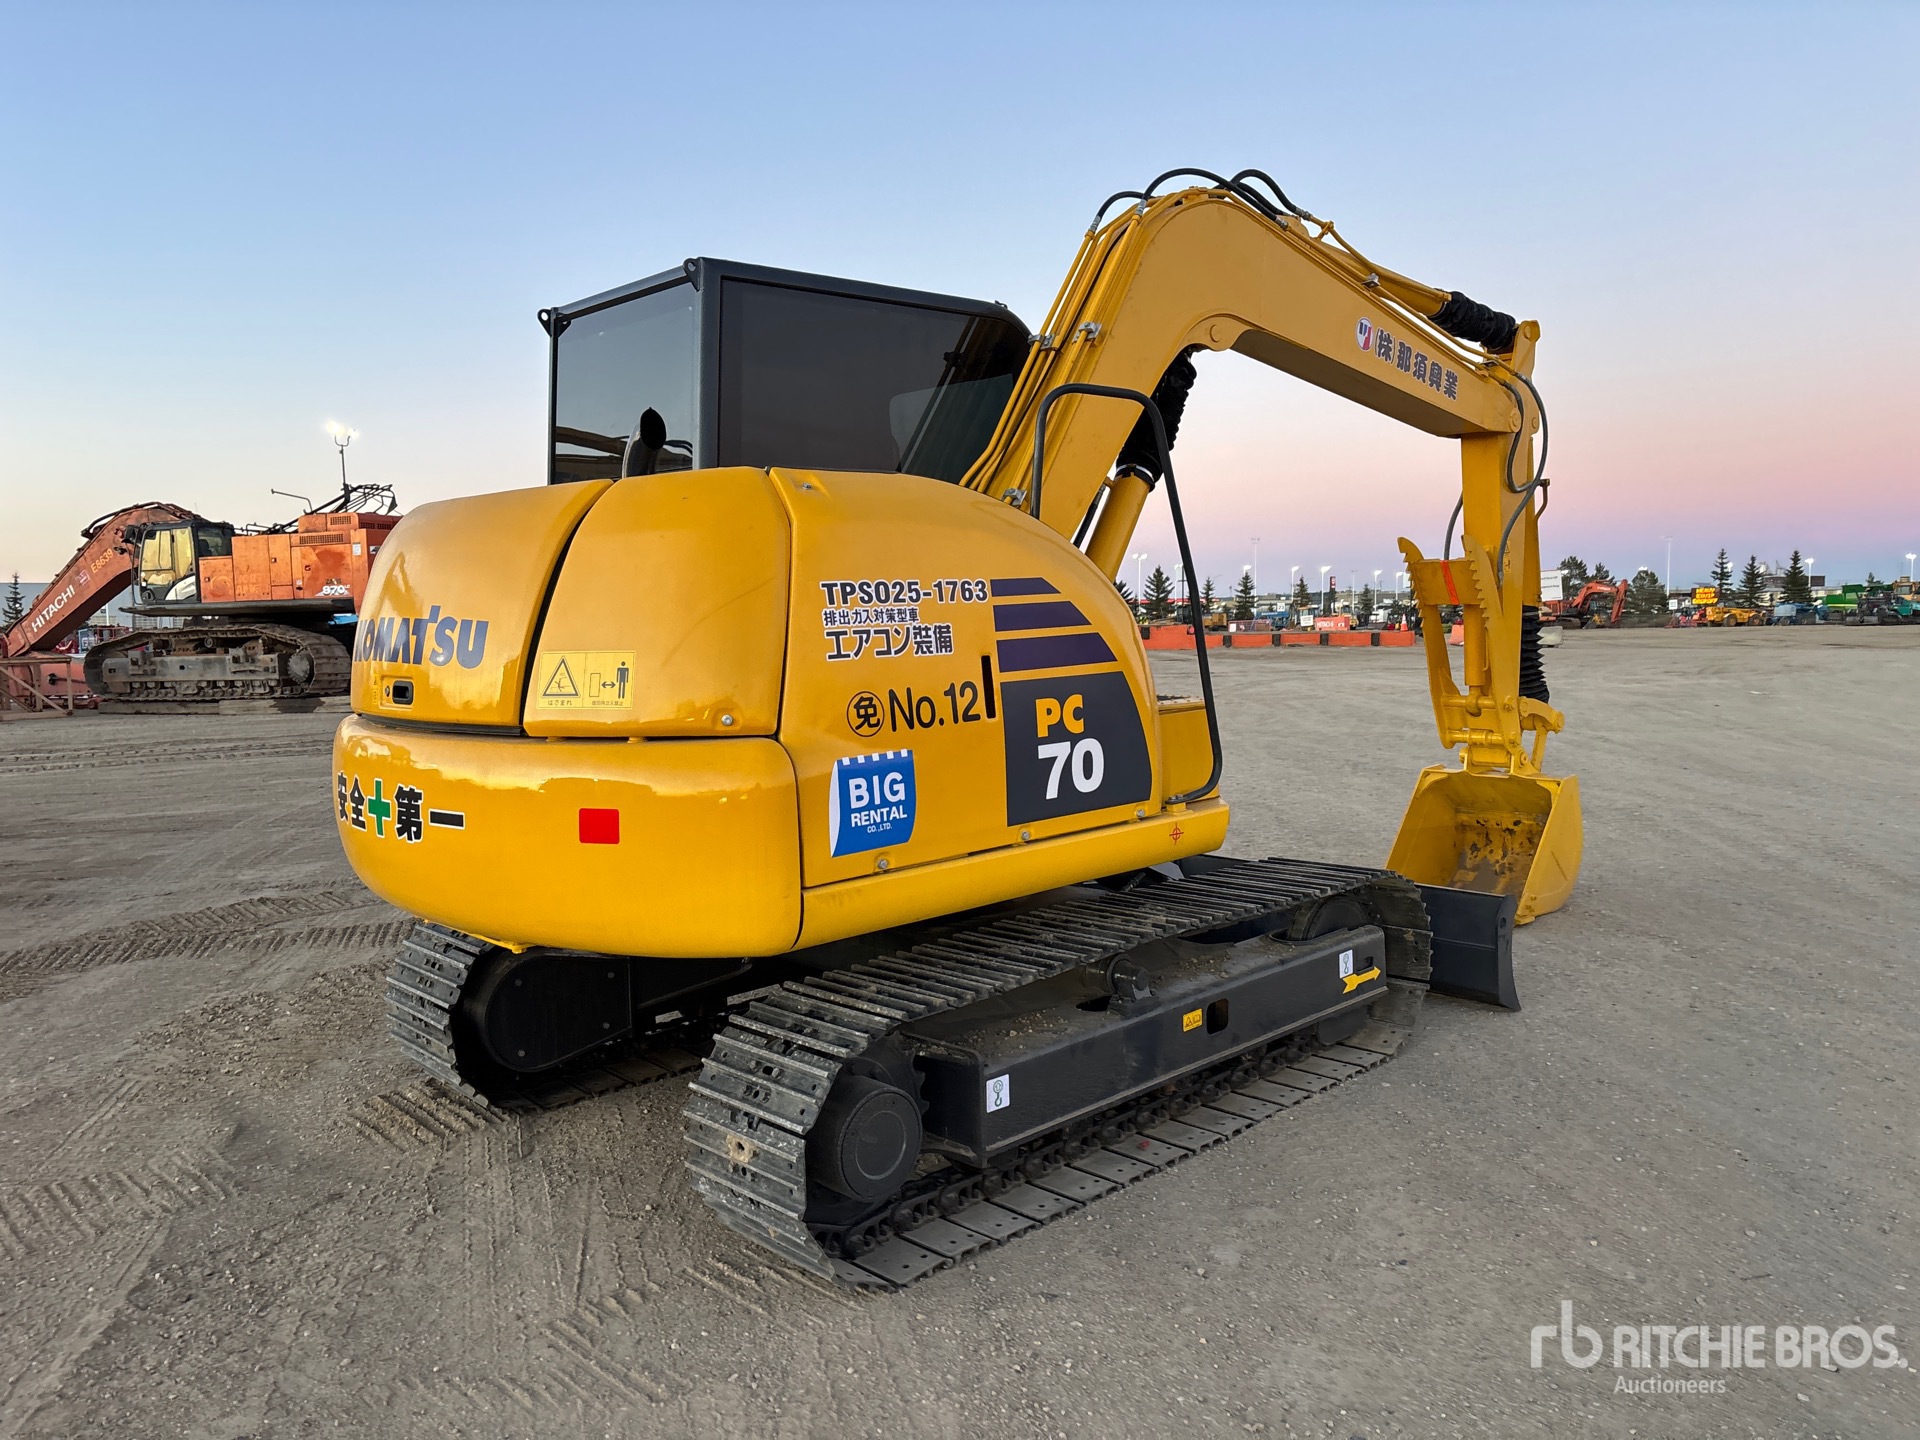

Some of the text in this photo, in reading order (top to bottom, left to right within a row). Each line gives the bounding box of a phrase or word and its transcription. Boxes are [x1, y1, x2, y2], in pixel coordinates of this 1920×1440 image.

[31, 584, 76, 632] HITACHI
[322, 585, 345, 595] 870
[821, 580, 988, 606] TPS025-1763
[823, 608, 920, 626] 排出ガス対策型車
[354, 605, 489, 669] KOMATSU
[825, 624, 953, 660] エアコン装備
[888, 680, 981, 732] No.12
[1035, 693, 1085, 738] PC
[1037, 738, 1105, 800] 70
[848, 771, 906, 809] BIG
[850, 804, 908, 828] RENTAL
